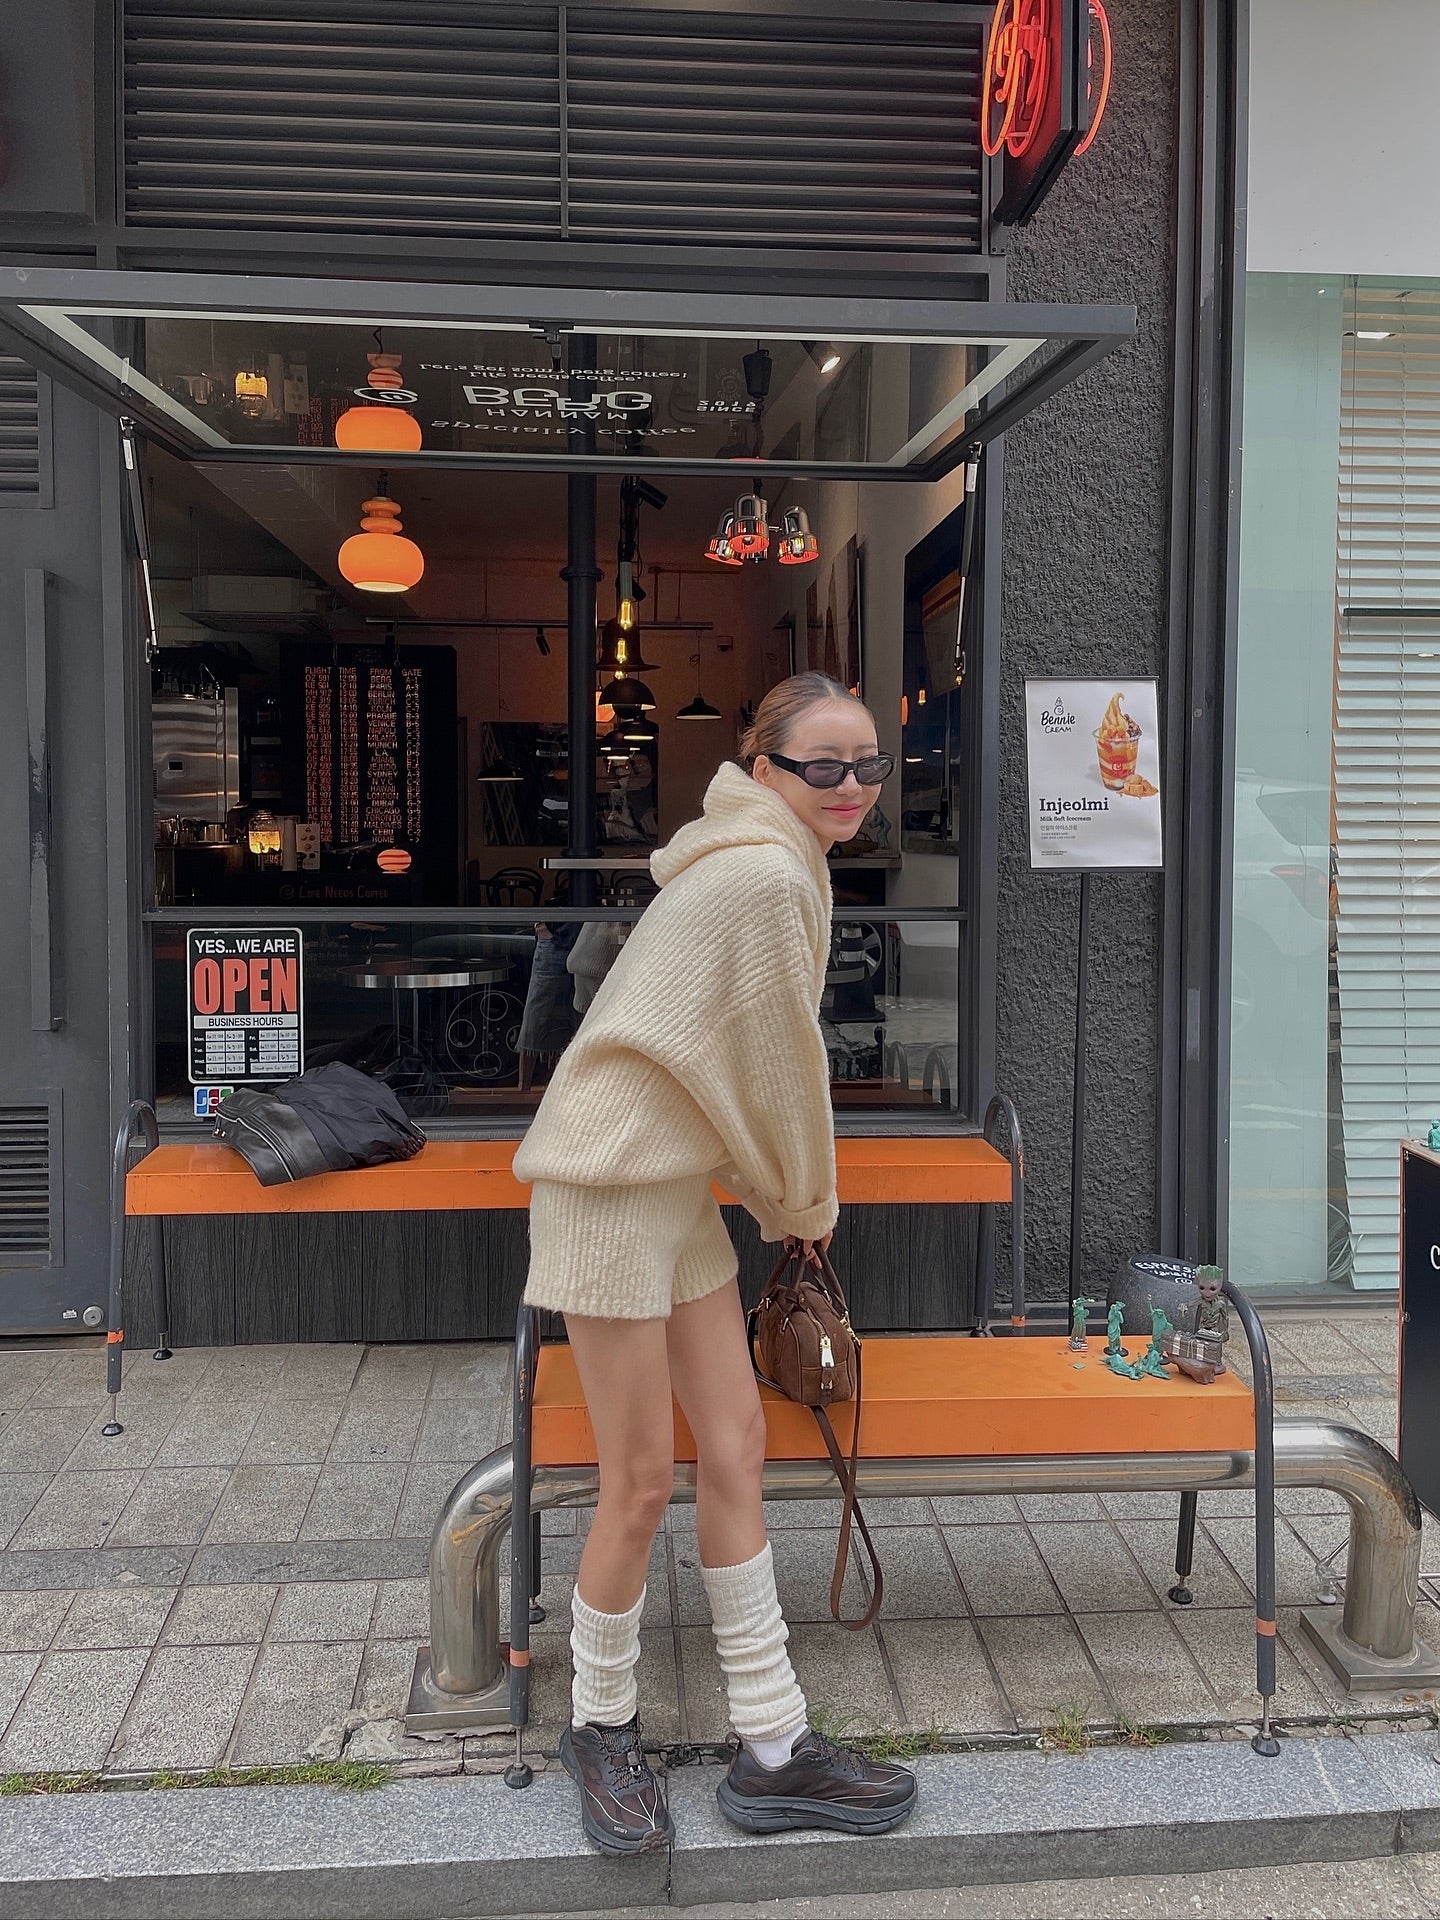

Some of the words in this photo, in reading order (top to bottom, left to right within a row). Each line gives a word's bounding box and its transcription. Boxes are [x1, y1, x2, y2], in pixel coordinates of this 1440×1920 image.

[338, 667, 357, 675] TIME
[369, 668, 393, 676] FROM
[401, 669, 422, 677] GATE
[1041, 710, 1076, 726] Bennie
[1044, 725, 1072, 734] CREAM
[367, 770, 399, 778] SYDNEY
[1039, 797, 1110, 815] Injeolmi
[364, 813, 402, 821] TORONTO
[263, 938, 295, 953] ARE
[193, 957, 298, 1015] OPEN
[208, 1017, 251, 1027] BUSINESS
[252, 1016, 284, 1026] HOURS
